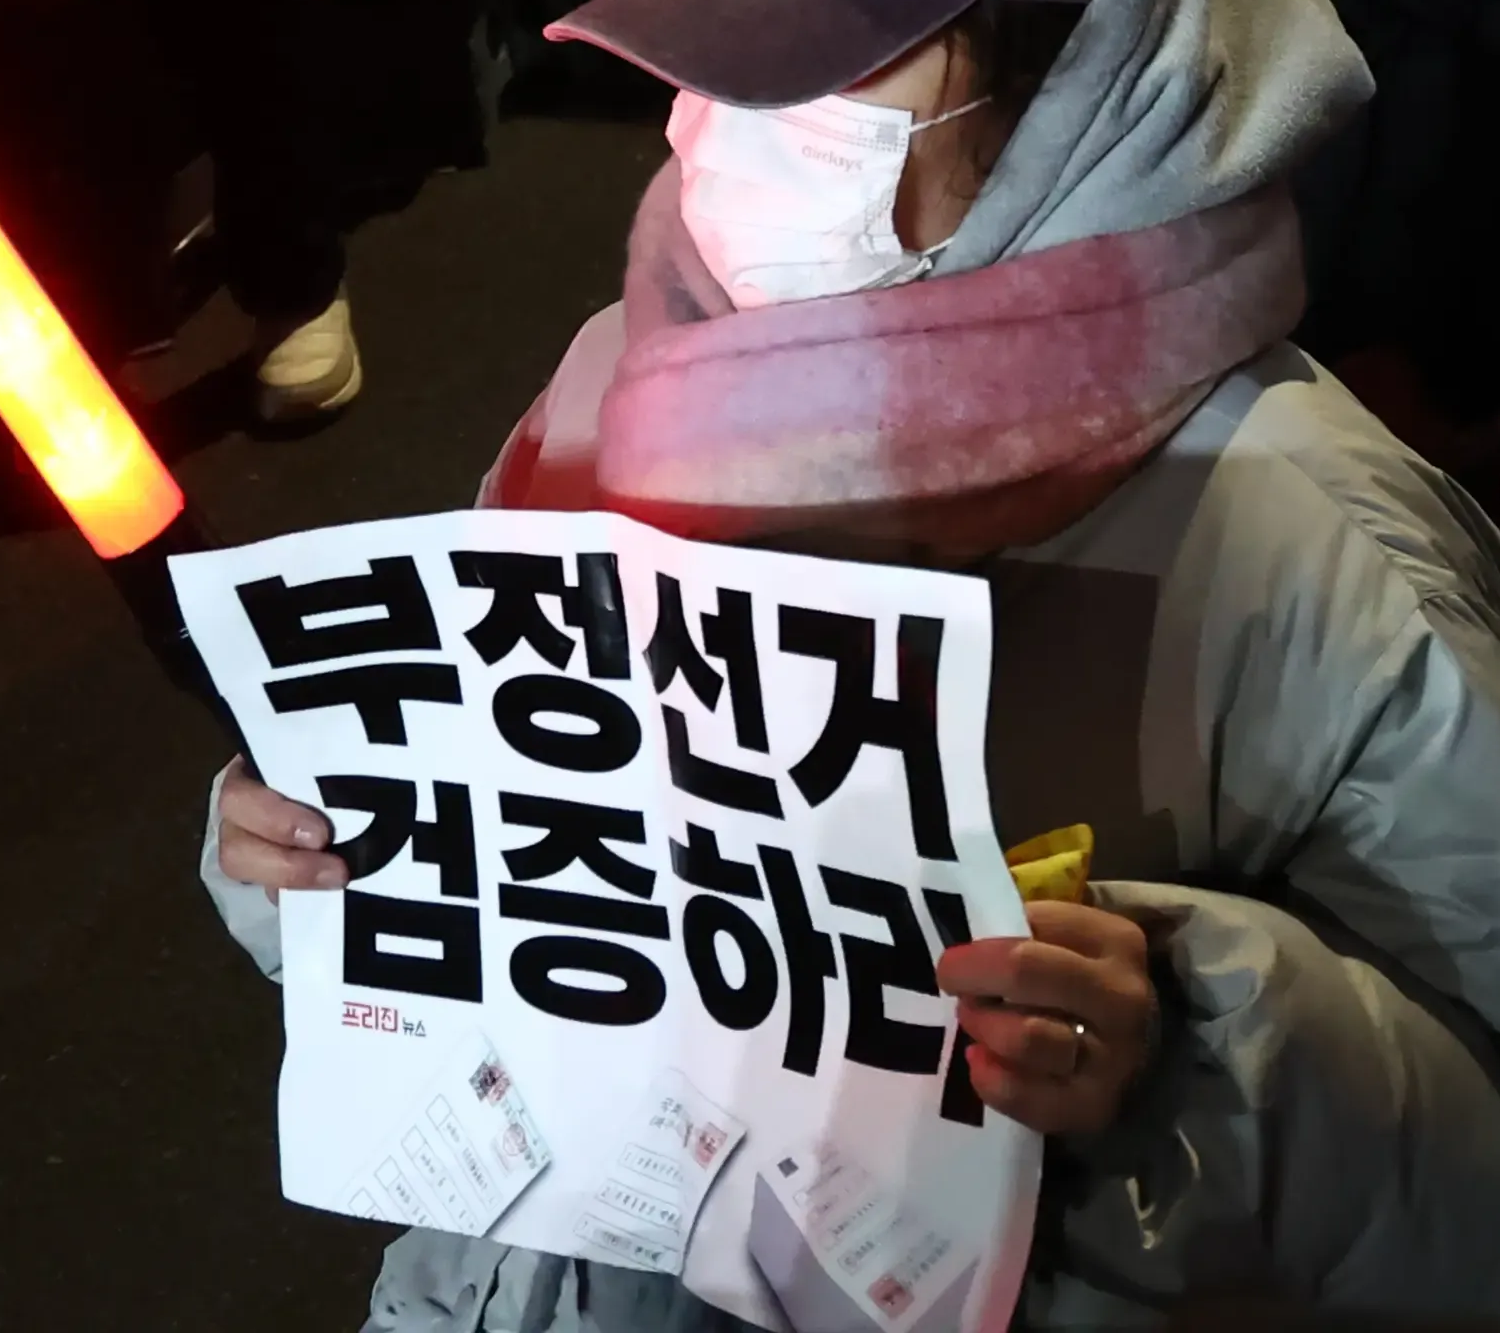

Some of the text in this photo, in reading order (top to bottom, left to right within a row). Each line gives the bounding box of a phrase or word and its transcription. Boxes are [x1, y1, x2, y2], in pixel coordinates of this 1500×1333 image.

[235, 548, 960, 863] 부정선거
[342, 1001, 428, 1038] 프리진 뉴스
